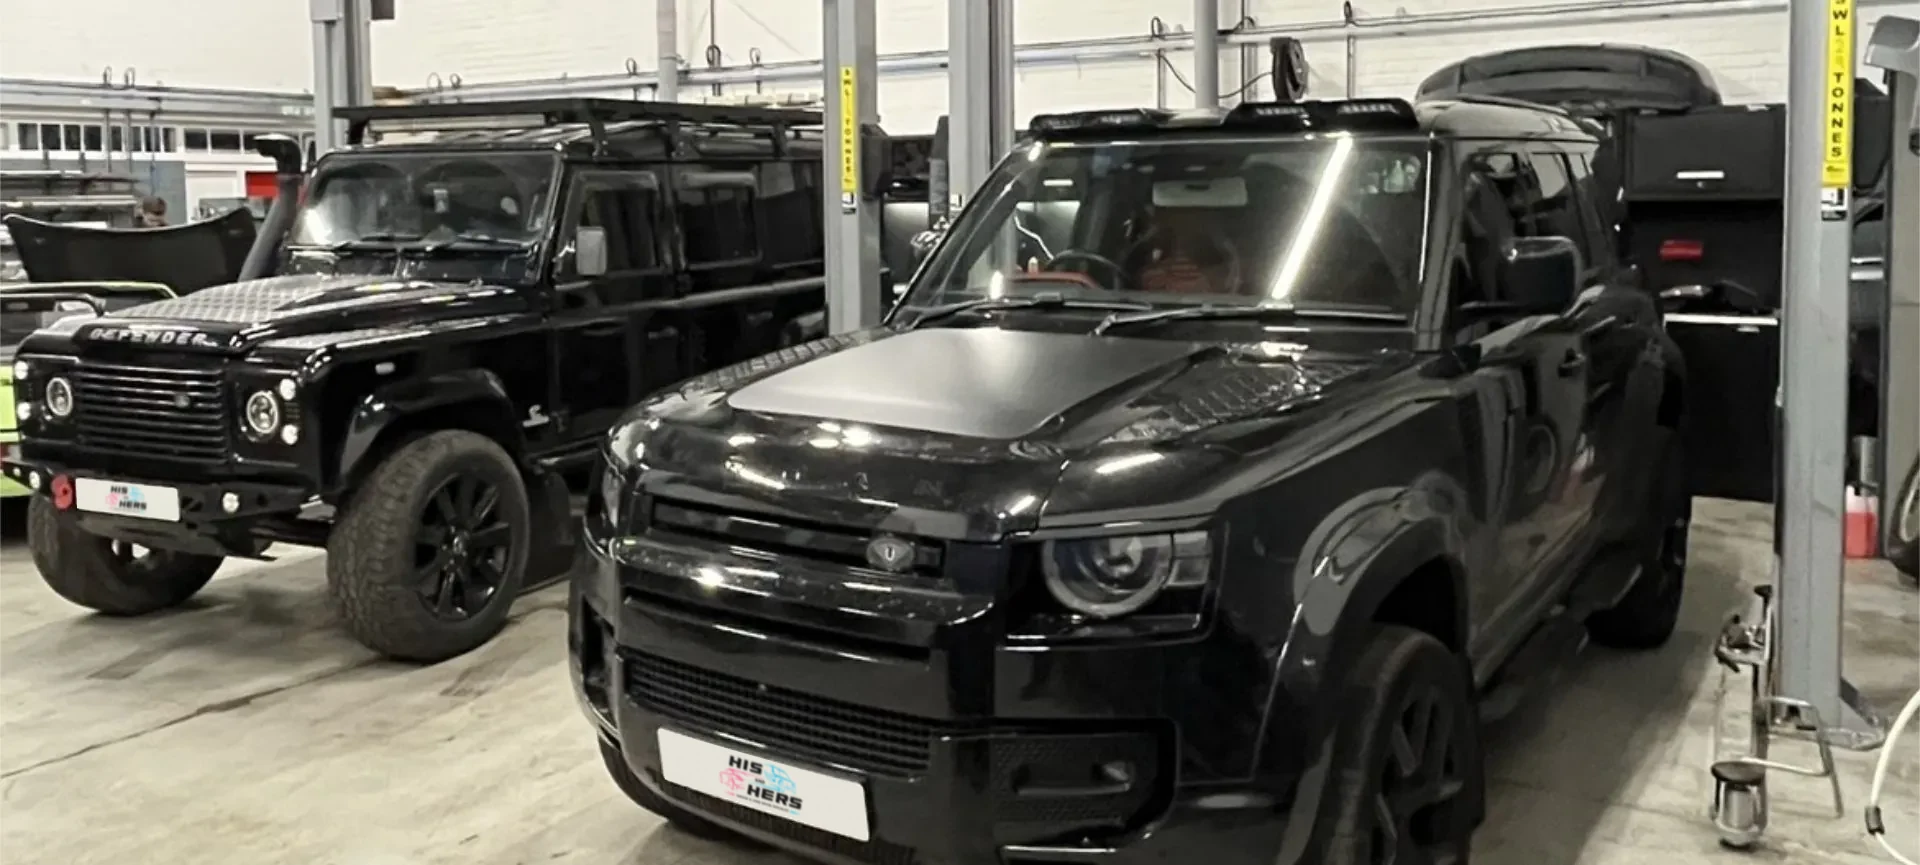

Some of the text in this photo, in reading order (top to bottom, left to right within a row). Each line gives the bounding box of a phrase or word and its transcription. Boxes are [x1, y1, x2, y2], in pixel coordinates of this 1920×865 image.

[1831, 71, 1845, 158] TONNES
[843, 116, 852, 174] TONNES
[90, 328, 209, 346] DEFENDER
[110, 486, 128, 495] HIS
[119, 500, 147, 511] HERS
[728, 755, 763, 775] HIS
[747, 783, 803, 810] HERS
